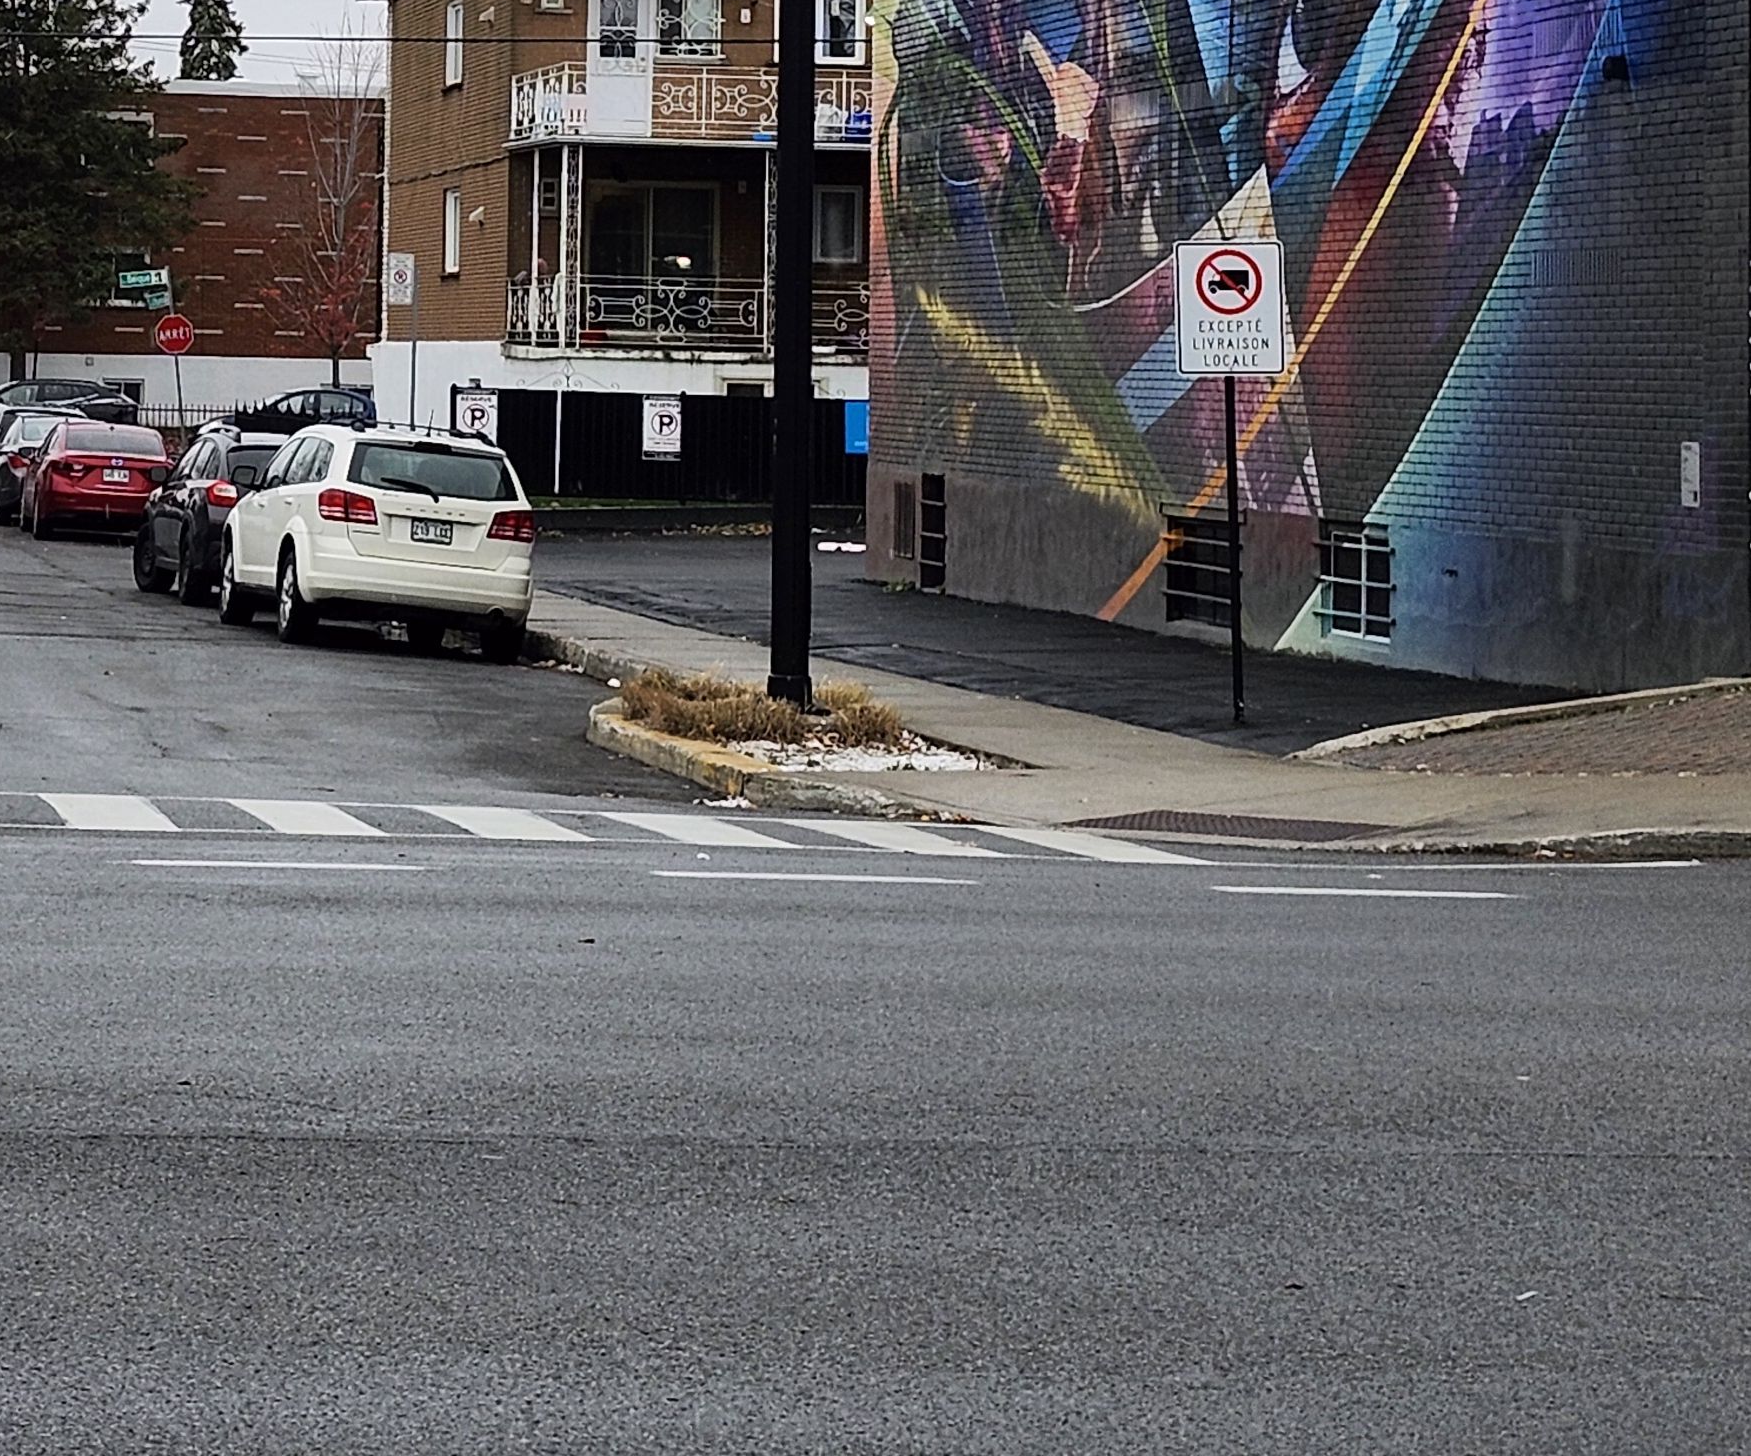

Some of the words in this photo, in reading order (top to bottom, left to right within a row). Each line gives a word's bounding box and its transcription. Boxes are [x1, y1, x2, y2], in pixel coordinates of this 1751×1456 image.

[1198, 318, 1262, 333] EXCEPTÉ
[1193, 337, 1270, 350] LIVRAISON
[1204, 354, 1258, 367] LOCALE
